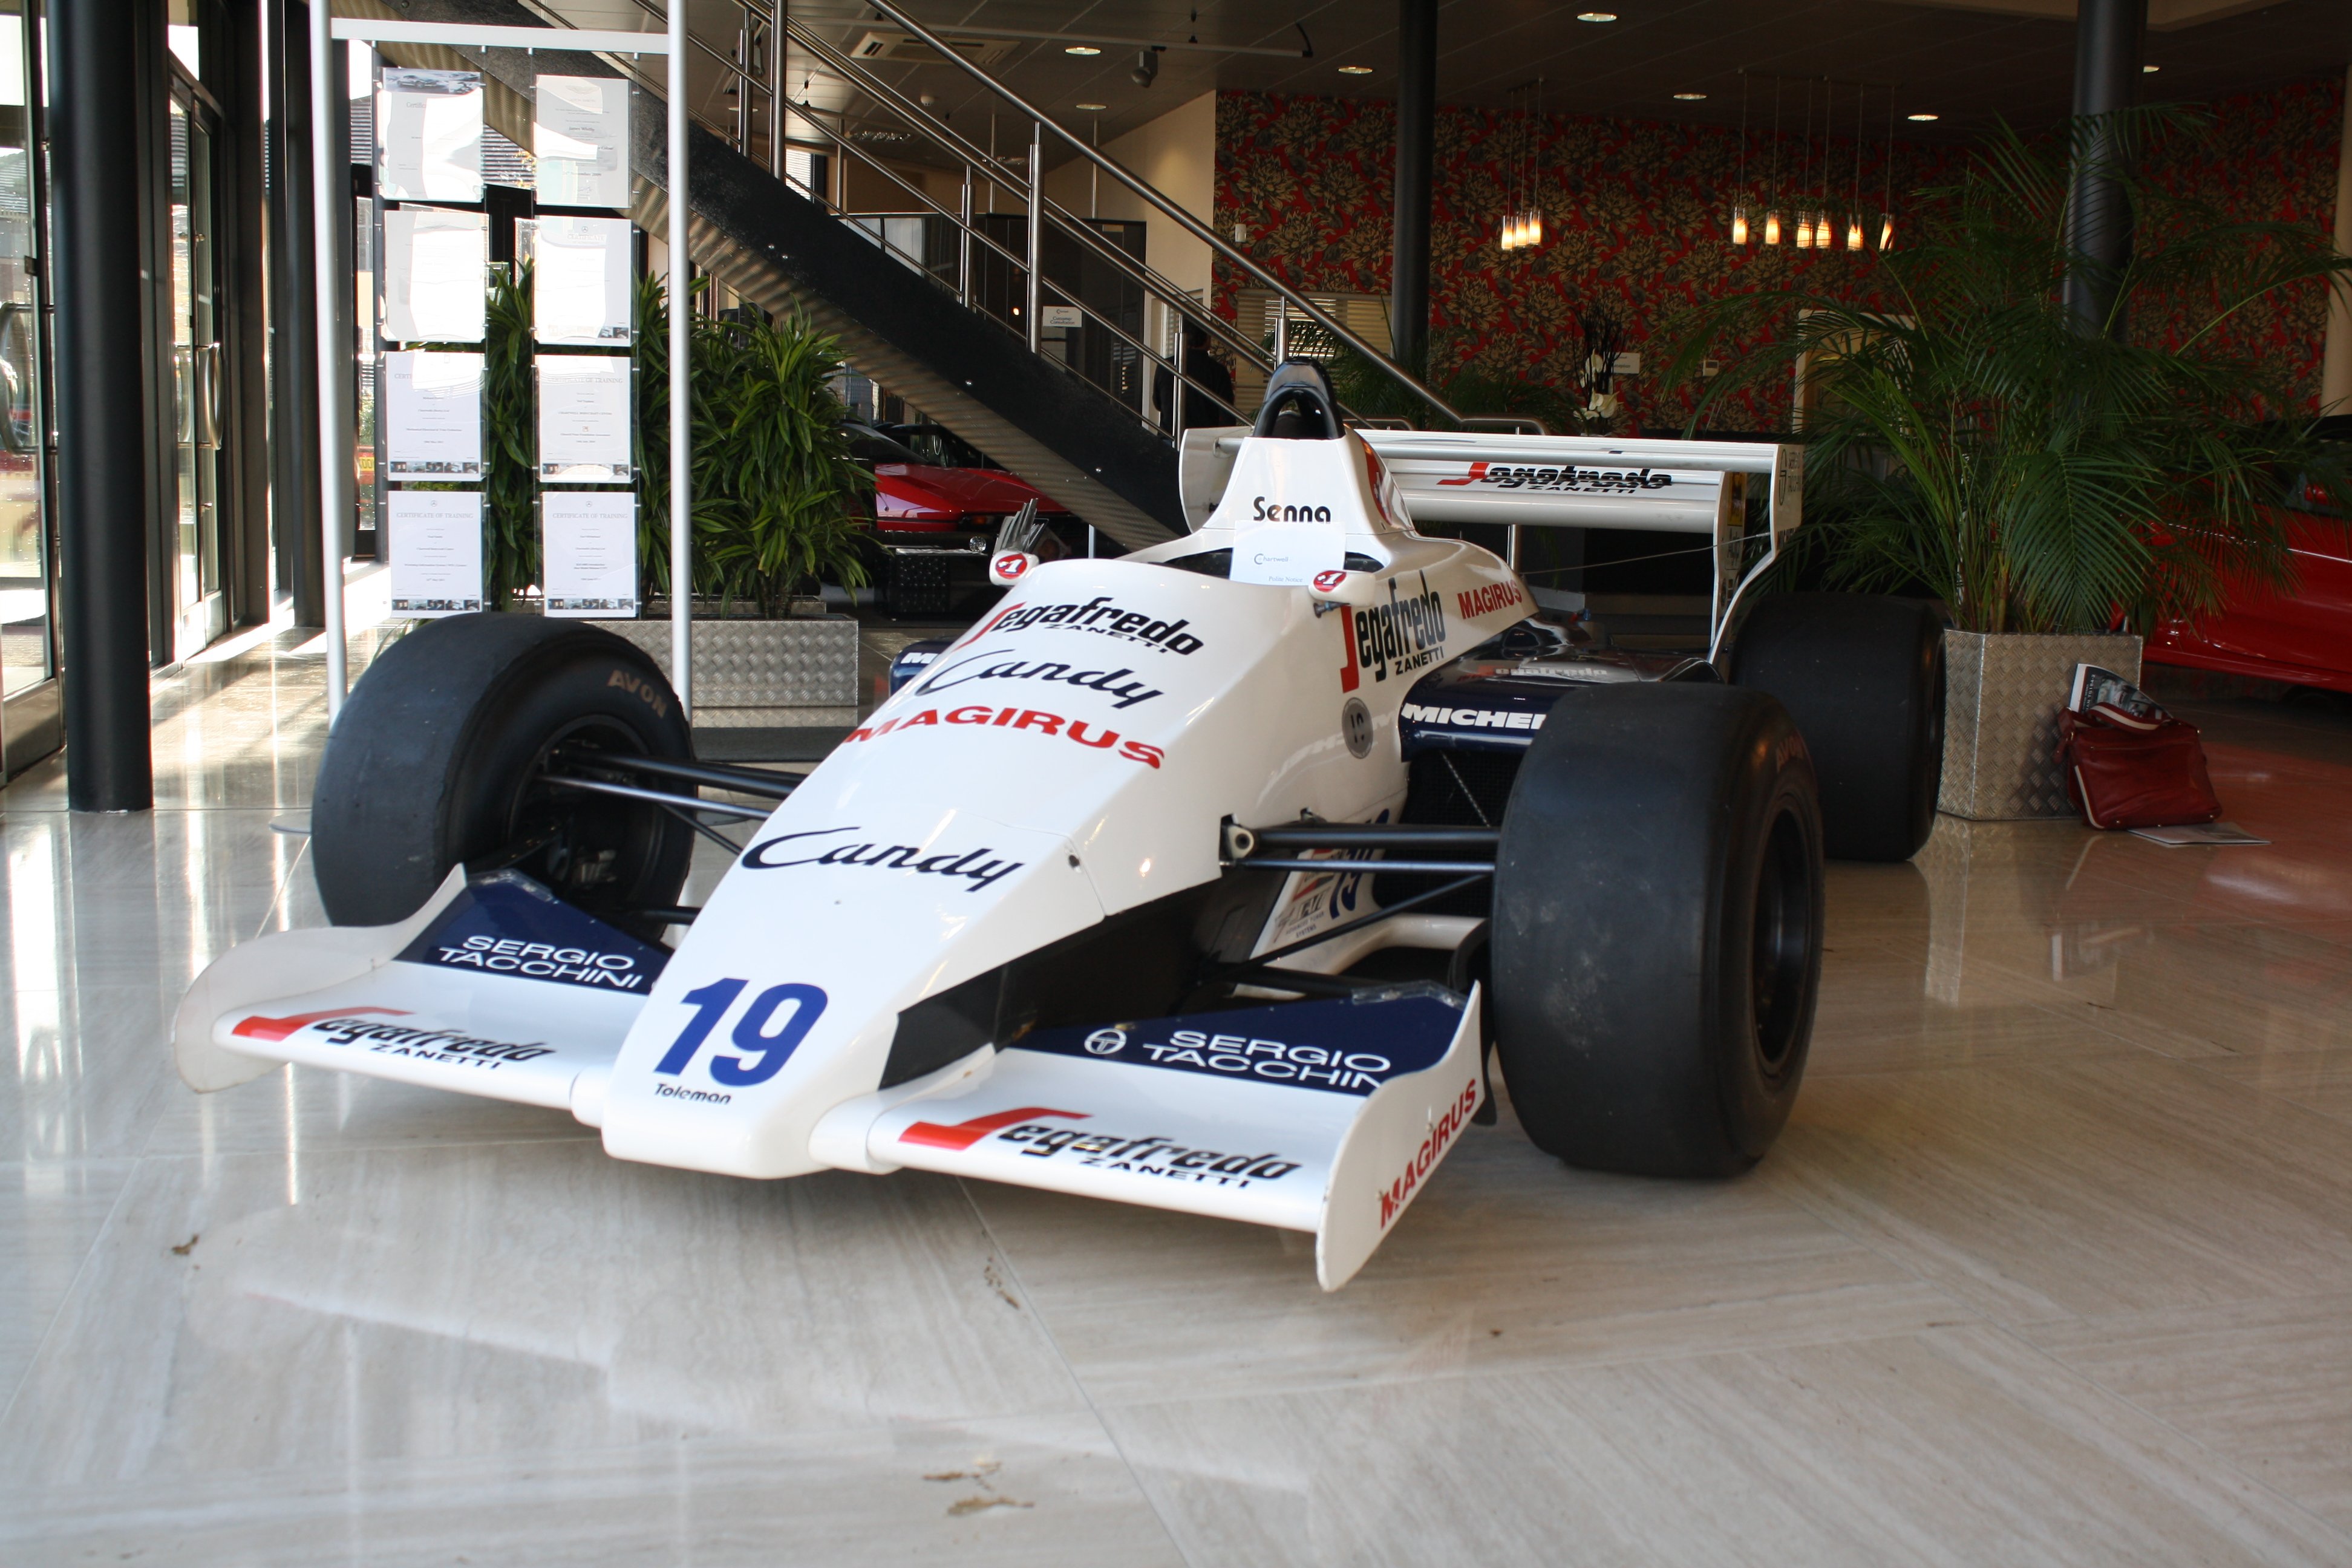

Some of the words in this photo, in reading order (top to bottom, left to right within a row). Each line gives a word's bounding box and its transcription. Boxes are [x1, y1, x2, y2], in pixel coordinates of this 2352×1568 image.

[1253, 495, 1331, 523] Senna
[1527, 486, 1636, 494] ZANETTI
[1253, 553, 1289, 565] Chartwell
[1457, 579, 1523, 620] MAGIRUS
[1045, 623, 1168, 655] ZANETTI
[914, 648, 1165, 710] Candy
[1395, 645, 1445, 676] ZANETTI
[607, 670, 668, 719] AVON
[843, 705, 1166, 770] MAGIRUS
[742, 826, 1025, 892] Candy
[439, 947, 643, 989] TACCHINI
[462, 935, 635, 971] SERGIO
[653, 978, 828, 1088] 19
[1169, 1030, 1391, 1073] SERGIO
[374, 1043, 503, 1070] ZANETTI
[1142, 1043, 1383, 1089] TACCHIN
[654, 1082, 731, 1105] Toleman
[1079, 1157, 1252, 1189] ZANETTI
[1380, 1078, 1477, 1231] MAGIRUS
